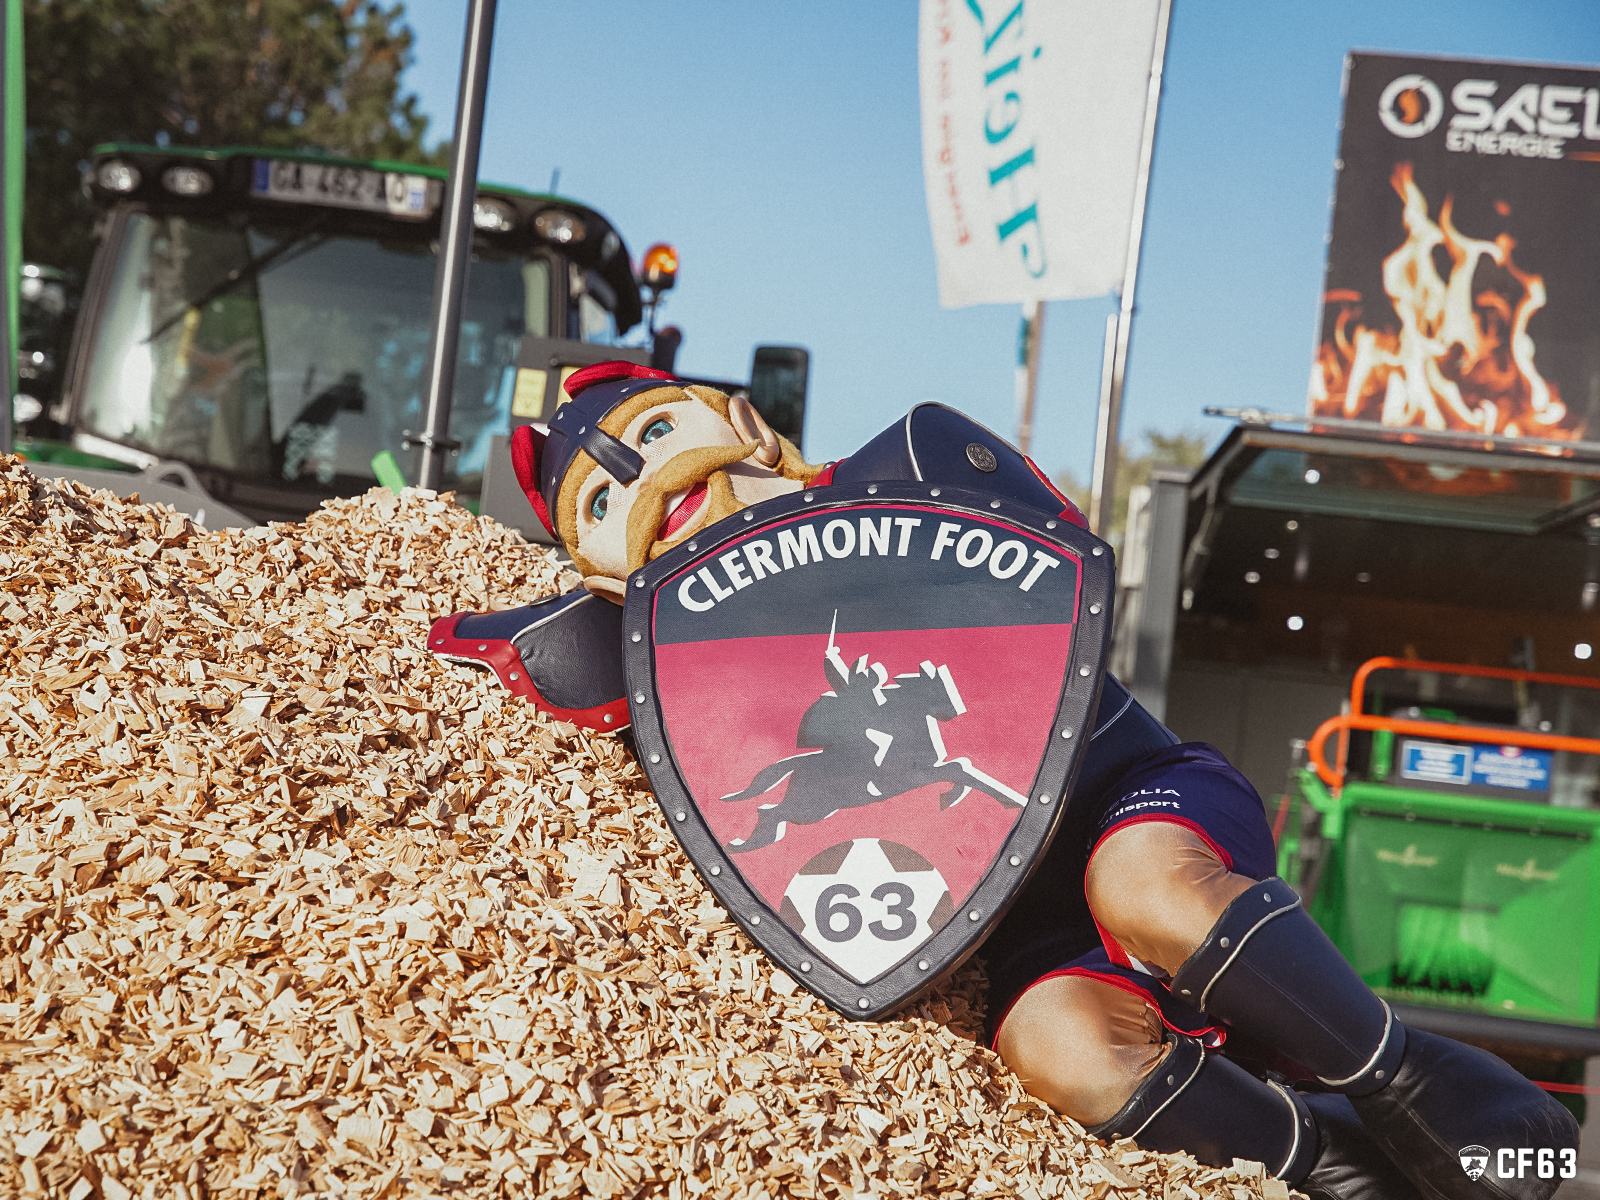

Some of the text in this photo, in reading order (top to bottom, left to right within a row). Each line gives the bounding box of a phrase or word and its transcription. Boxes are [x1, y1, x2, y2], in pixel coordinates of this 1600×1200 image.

[677, 516, 1061, 613] CLERMONT FOOT
[813, 881, 918, 943] 63
